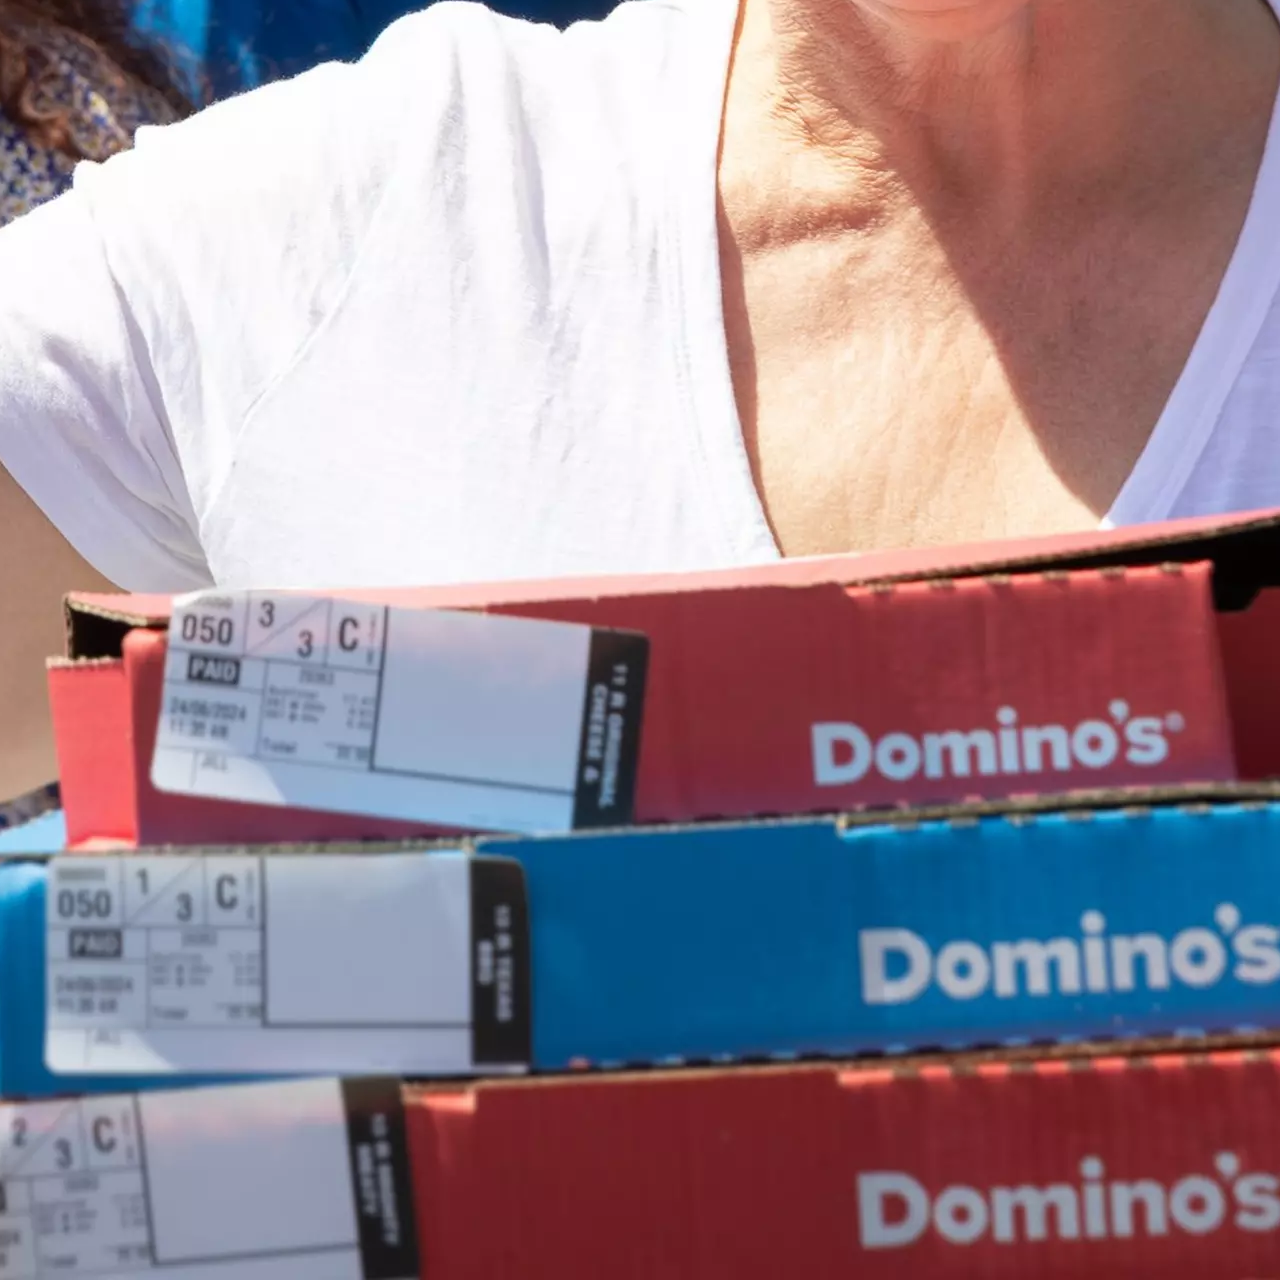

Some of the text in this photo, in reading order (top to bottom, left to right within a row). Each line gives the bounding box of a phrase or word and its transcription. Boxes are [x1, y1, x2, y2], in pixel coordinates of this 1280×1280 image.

[258, 599, 276, 629] 3
[181, 613, 234, 648] 050
[296, 628, 315, 660] 3
[337, 615, 360, 653] C
[191, 658, 238, 683] PAID
[811, 698, 1170, 786] Domino's
[136, 867, 150, 896] 1
[214, 873, 238, 911] C
[57, 888, 112, 919] 050
[175, 891, 194, 922] 3
[12, 1117, 28, 1147] 2
[92, 1115, 118, 1154] C
[52, 1136, 74, 1170] 3
